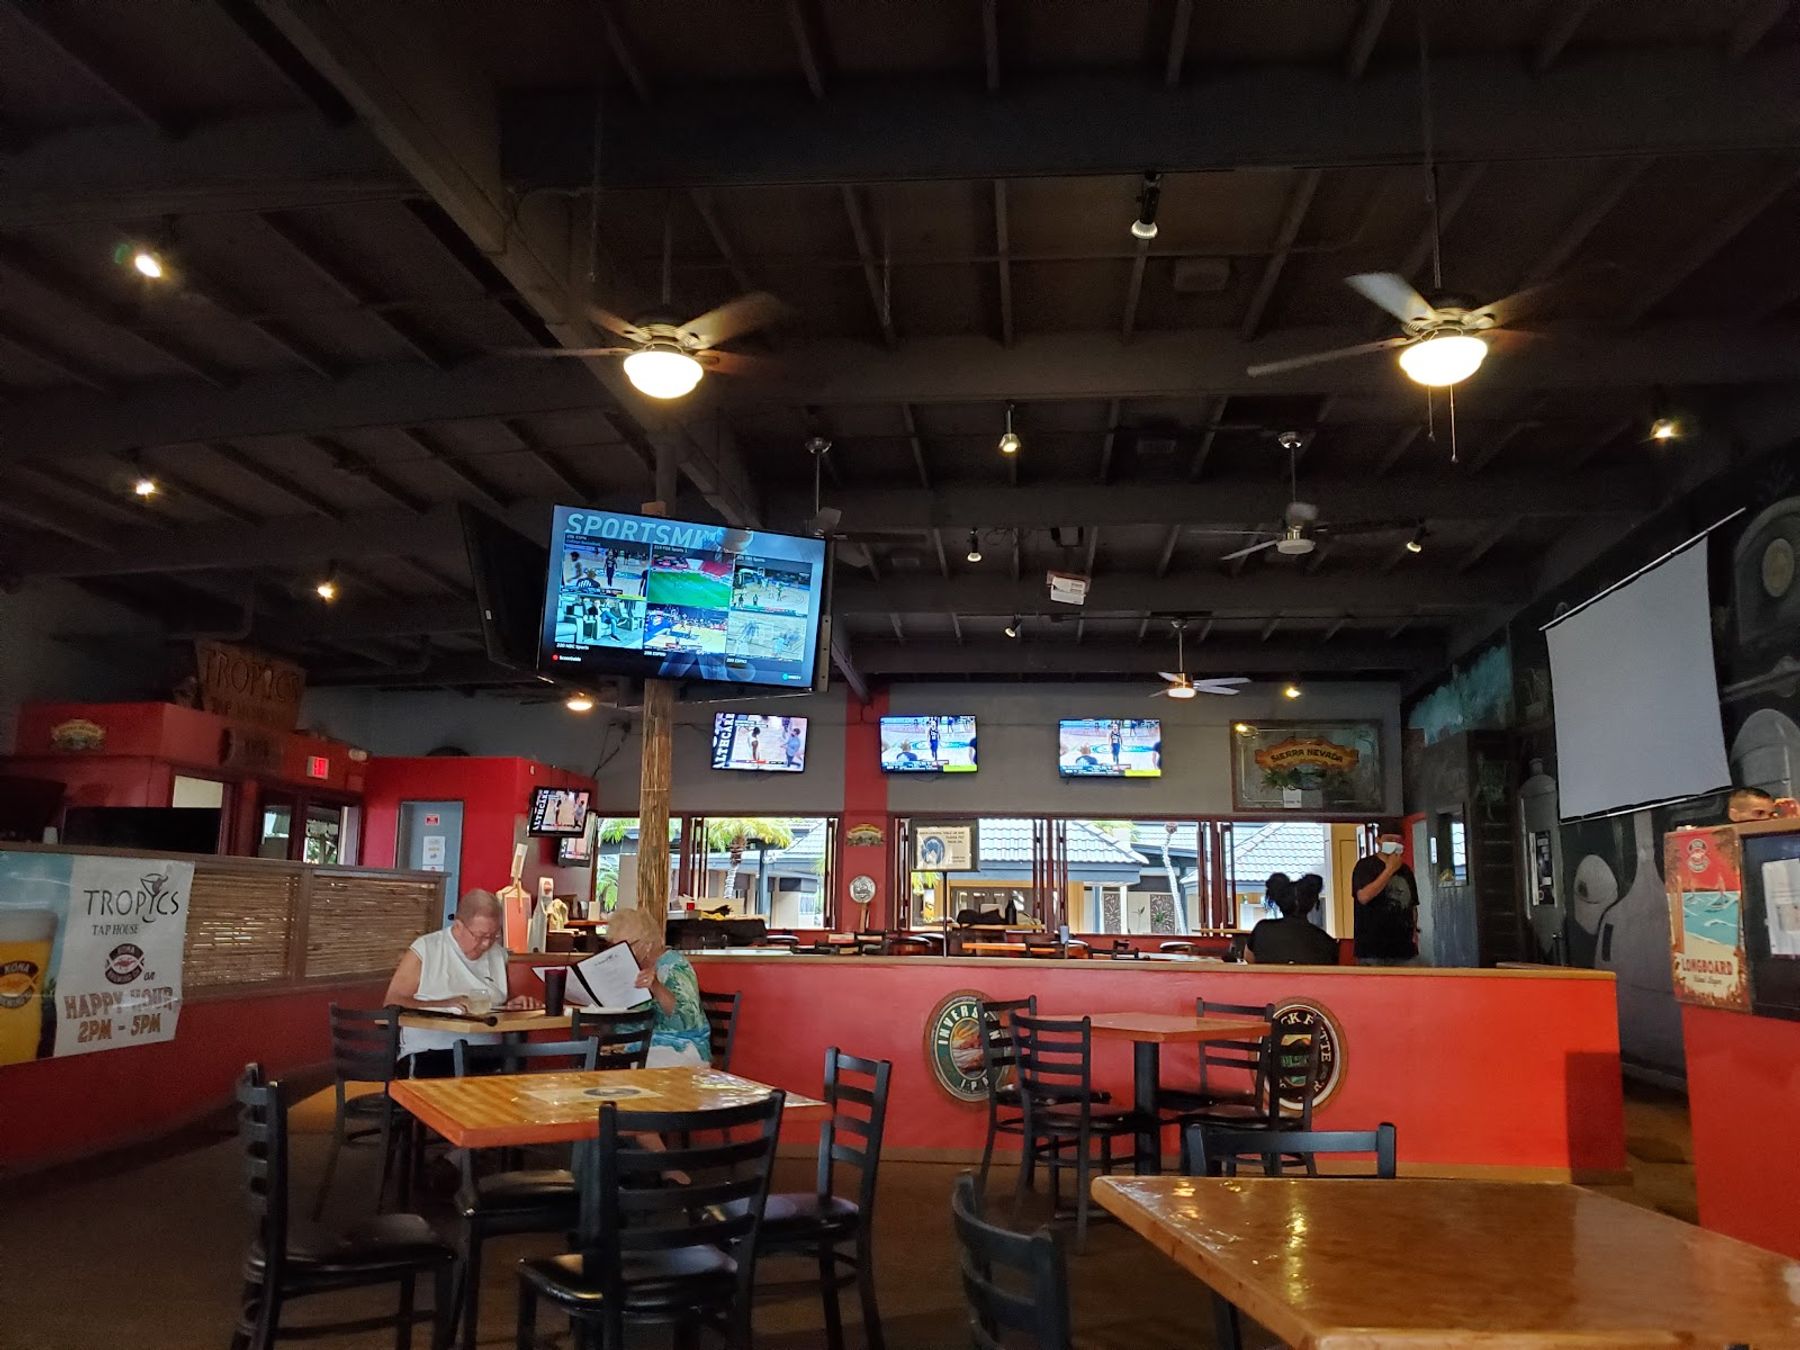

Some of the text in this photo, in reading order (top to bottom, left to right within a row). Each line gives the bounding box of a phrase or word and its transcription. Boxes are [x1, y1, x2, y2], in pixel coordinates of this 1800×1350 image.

[1270, 748, 1344, 762] SIERRA NEVADA
[1681, 958, 1733, 976] LONGBOARD
[63, 992, 124, 1020] HAPPY
[77, 1018, 113, 1043] 2PM
[130, 1012, 161, 1036] 5PM
